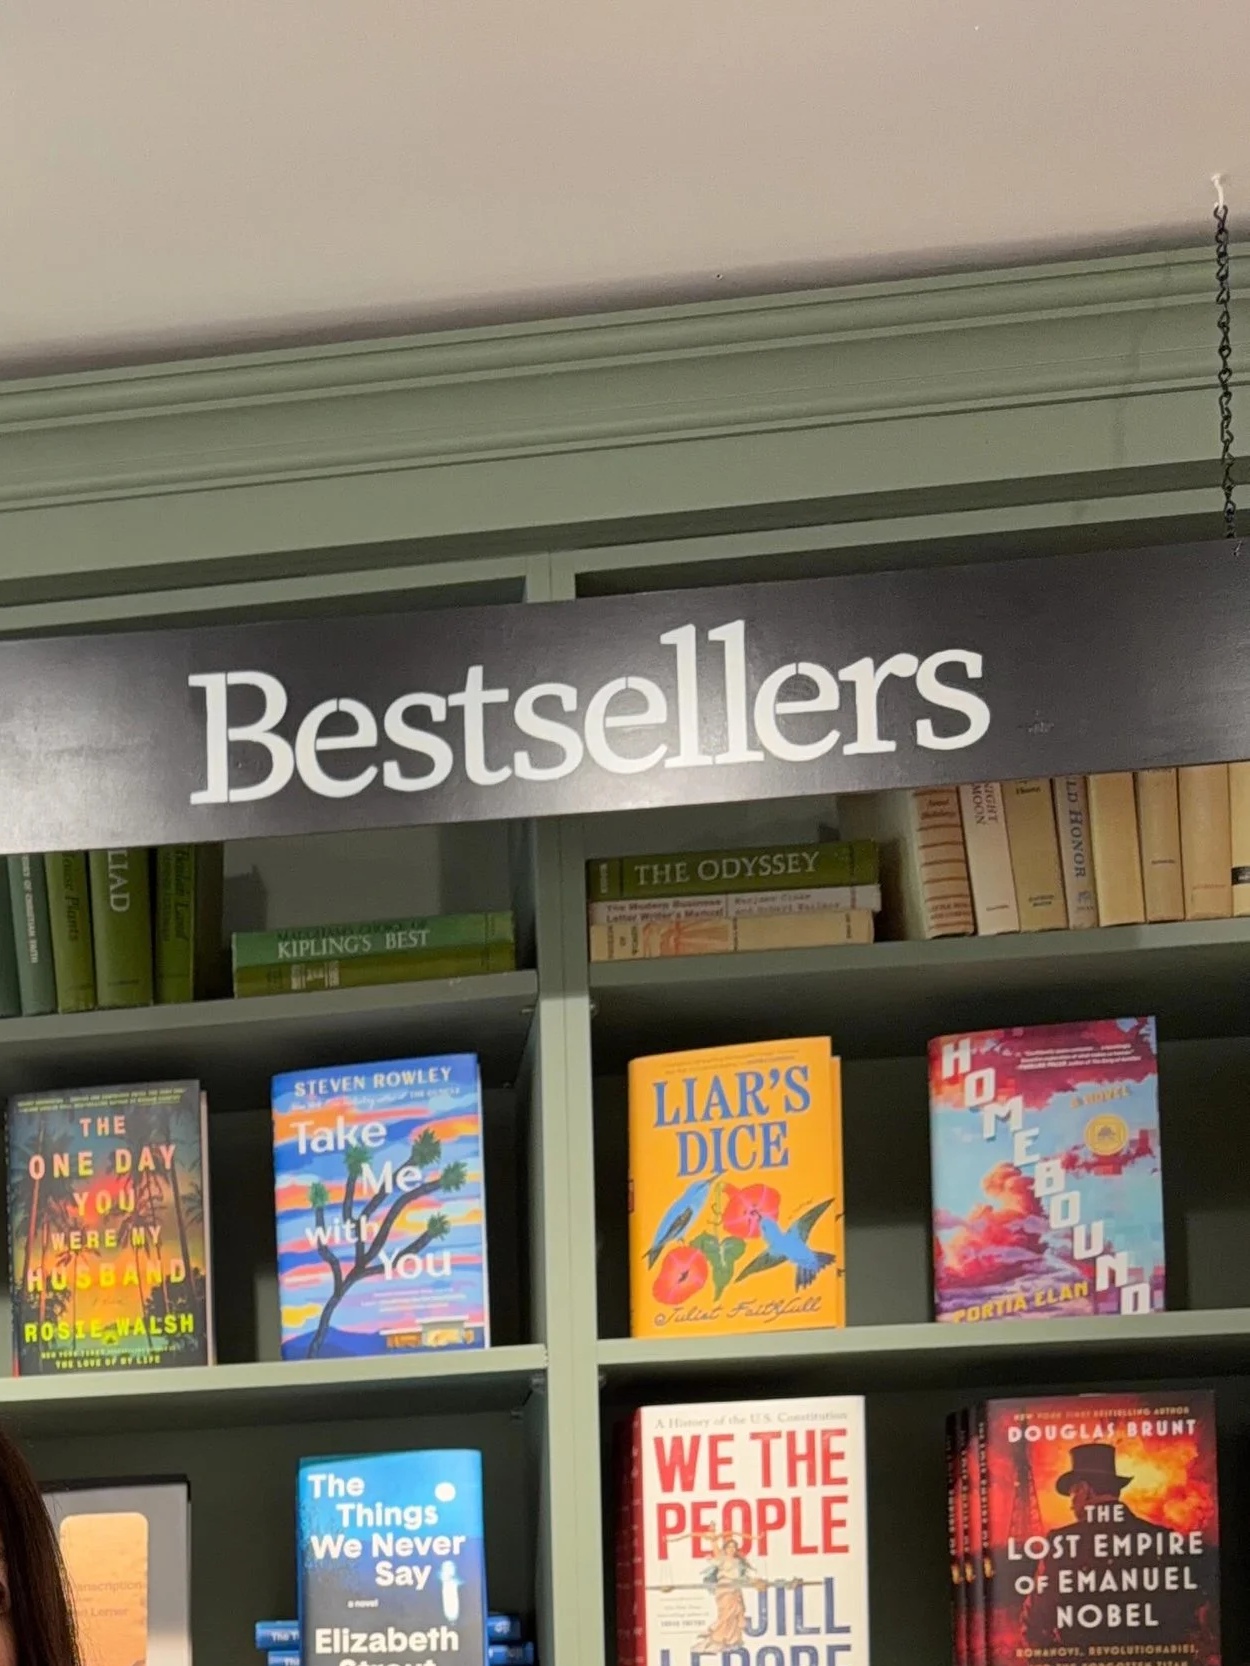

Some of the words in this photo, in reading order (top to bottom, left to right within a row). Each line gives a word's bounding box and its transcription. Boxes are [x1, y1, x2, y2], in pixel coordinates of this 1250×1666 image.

[188, 619, 991, 804] Bestsellers
[1069, 809, 1086, 878] HONOR
[634, 861, 690, 885] THE
[697, 851, 820, 881] ODYSSEY
[276, 934, 371, 960] KIPLING'S
[384, 929, 432, 950] BEST
[294, 1076, 365, 1097] STEVEN
[373, 1066, 452, 1088] ROWLEY
[652, 1065, 811, 1128] LIAR'S
[79, 1117, 127, 1137] THE
[290, 1117, 387, 1154] Take
[29, 1151, 95, 1180] ONE
[115, 1145, 177, 1172] DAY
[676, 1122, 790, 1177] DICE
[361, 1161, 423, 1194] Me
[73, 1189, 136, 1217] YOU
[51, 1230, 117, 1252] WERE
[132, 1225, 162, 1246] MY
[305, 1215, 379, 1246] with
[26, 1259, 185, 1292] HUSBAND
[378, 1250, 450, 1280] You
[954, 1296, 1027, 1323] PORTIA
[1034, 1280, 1089, 1304] ELAN
[24, 1319, 102, 1343] ROSIE
[116, 1314, 194, 1336] WALSH
[1008, 1423, 1117, 1443] DOUGLAS
[1127, 1418, 1196, 1437] BRUNT
[654, 1435, 736, 1493] WE
[750, 1428, 847, 1487] THE
[307, 1473, 364, 1498] The
[337, 1504, 438, 1531] Things
[657, 1494, 849, 1560] PEOPLE
[1085, 1505, 1125, 1523] THE
[311, 1533, 363, 1560] We
[371, 1533, 465, 1557] Never
[1008, 1537, 1080, 1561] LOST
[1094, 1531, 1204, 1558] EMPIRE
[375, 1561, 431, 1590] Say
[1015, 1574, 1049, 1594] OF
[1059, 1568, 1198, 1594] EMANUEL
[745, 1576, 850, 1637] JILL
[1056, 1604, 1159, 1629] NOBEL
[314, 1626, 459, 1655] Elizabeth
